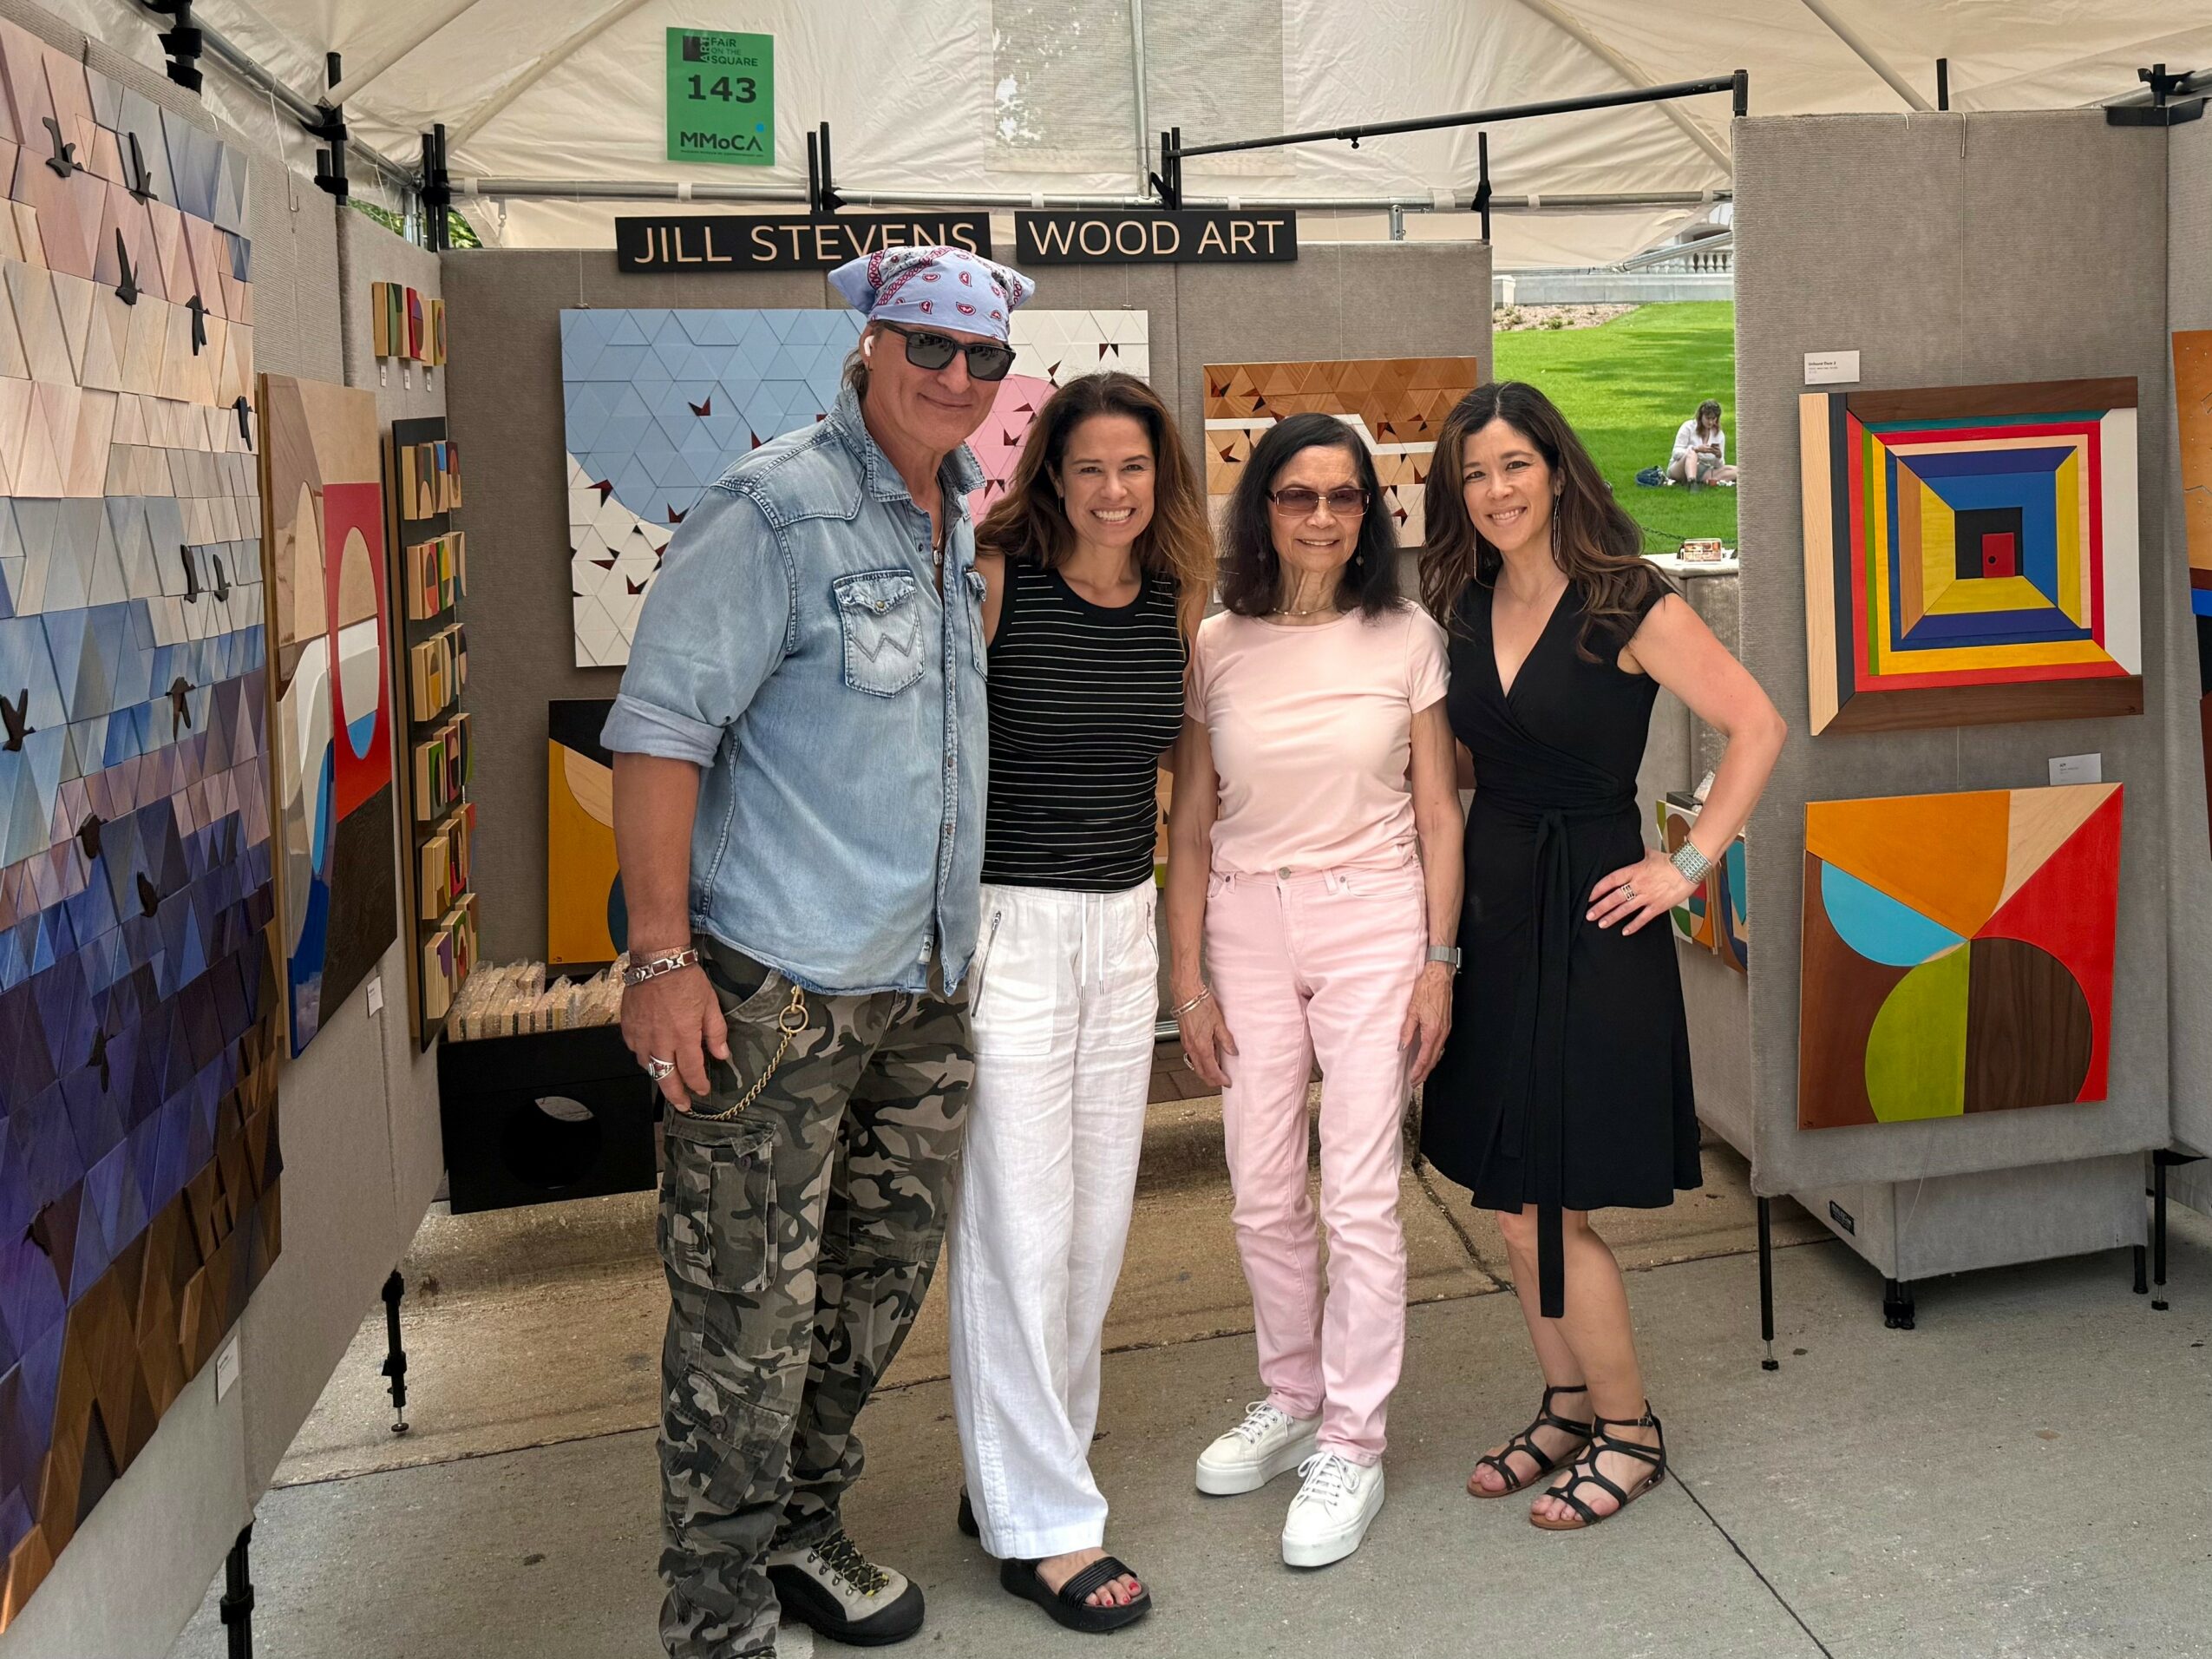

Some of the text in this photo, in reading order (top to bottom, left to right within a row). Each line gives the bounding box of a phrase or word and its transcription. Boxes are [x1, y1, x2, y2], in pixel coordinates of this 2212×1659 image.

[711, 56, 759, 67] SQUARE
[688, 75, 756, 103] 143
[634, 222, 978, 263] JILL STEVENS
[1028, 220, 1285, 256] WOOD ART
